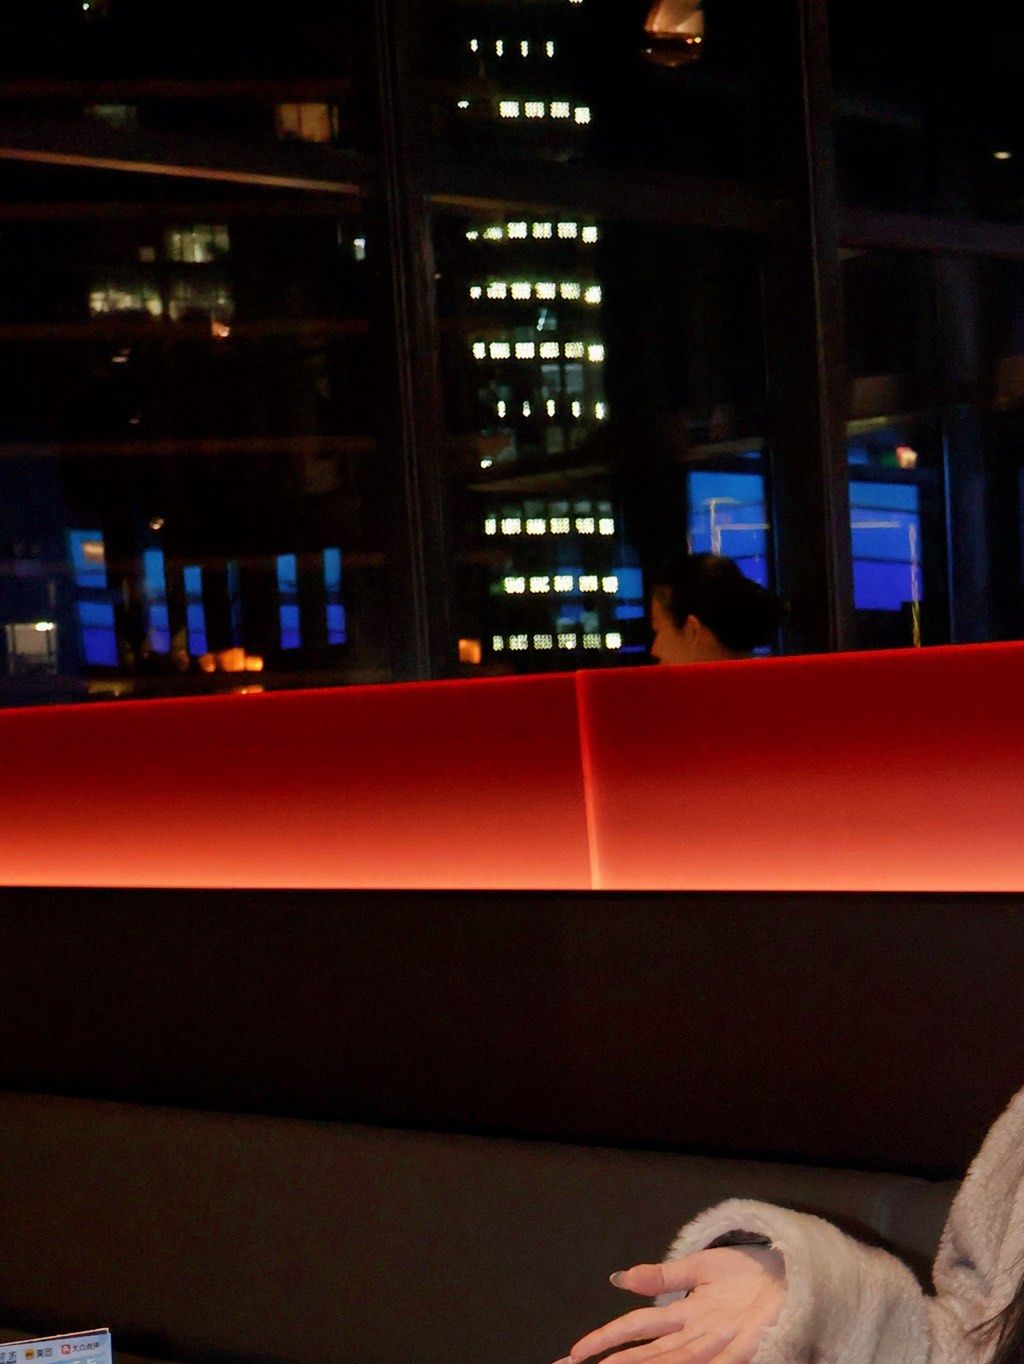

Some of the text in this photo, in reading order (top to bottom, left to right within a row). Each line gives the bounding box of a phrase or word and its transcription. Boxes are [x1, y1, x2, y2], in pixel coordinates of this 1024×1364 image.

[36, 1347, 53, 1358] 美团
[72, 1341, 100, 1353] 大众点评
